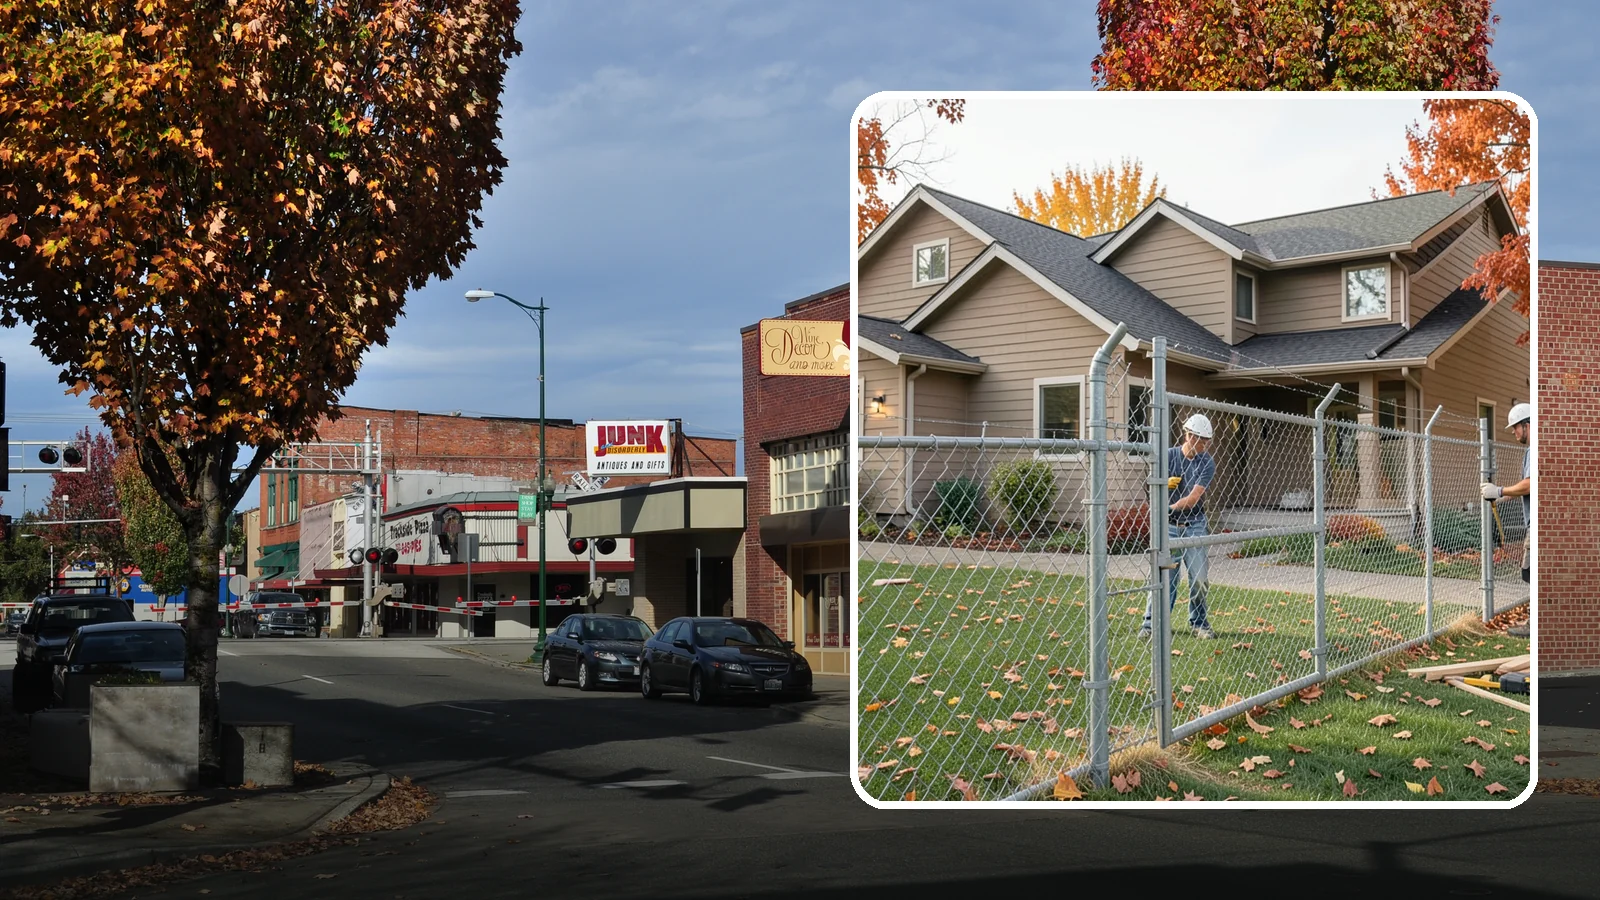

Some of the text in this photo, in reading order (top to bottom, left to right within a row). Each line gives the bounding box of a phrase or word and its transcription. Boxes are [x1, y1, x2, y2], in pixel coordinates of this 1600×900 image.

[595, 425, 665, 457] JUNK
[607, 446, 646, 454] DISORDERLY
[597, 460, 665, 470] ANTIQUES AND GIFTS
[390, 519, 429, 540] Trackside Pizza
